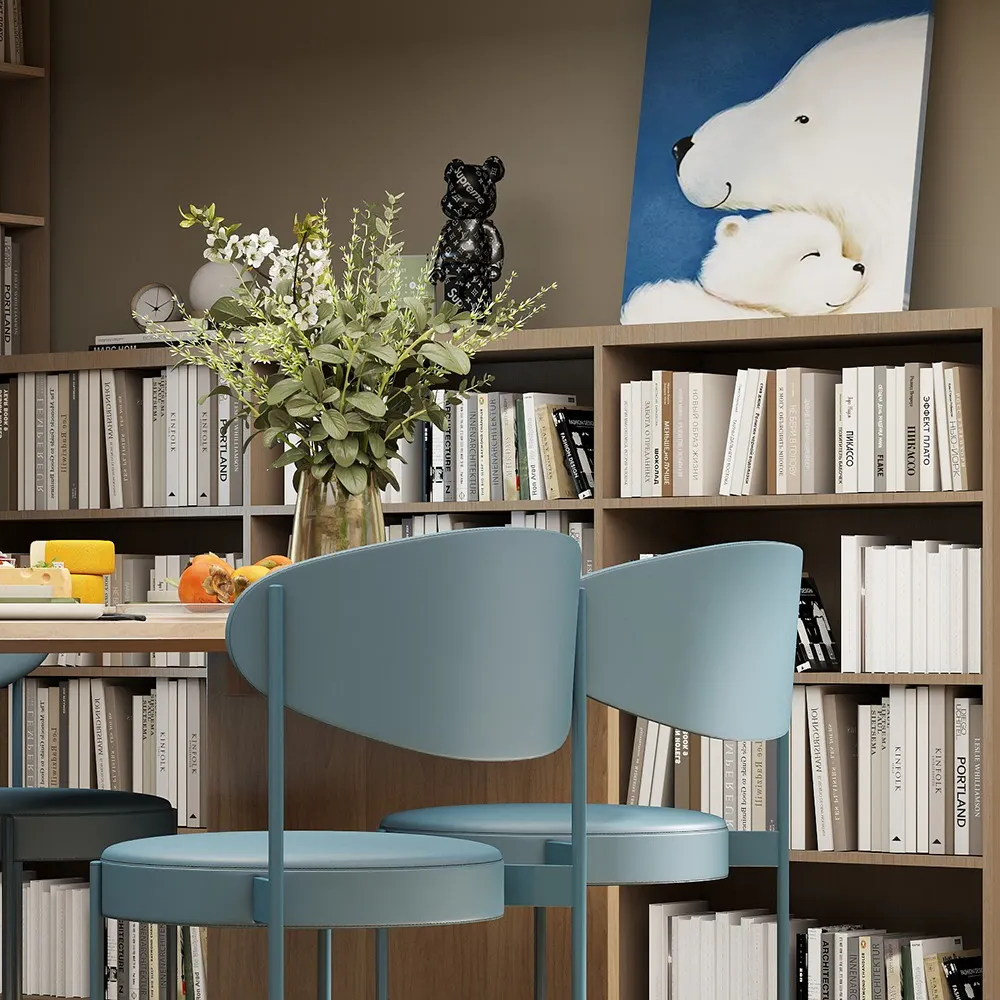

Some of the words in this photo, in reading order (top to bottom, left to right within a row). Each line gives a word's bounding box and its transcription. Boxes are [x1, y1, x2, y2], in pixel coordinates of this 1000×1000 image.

[490, 399, 499, 485] INNENARCHITEKTUR
[560, 433, 571, 457] FASHION
[568, 458, 578, 478] DESIGN
[846, 431, 854, 467] ПИКАССО
[907, 426, 916, 476] ПИКАССО
[950, 421, 960, 477] НЬЮ-ЙОРК
[957, 757, 966, 827] PORTLAND
